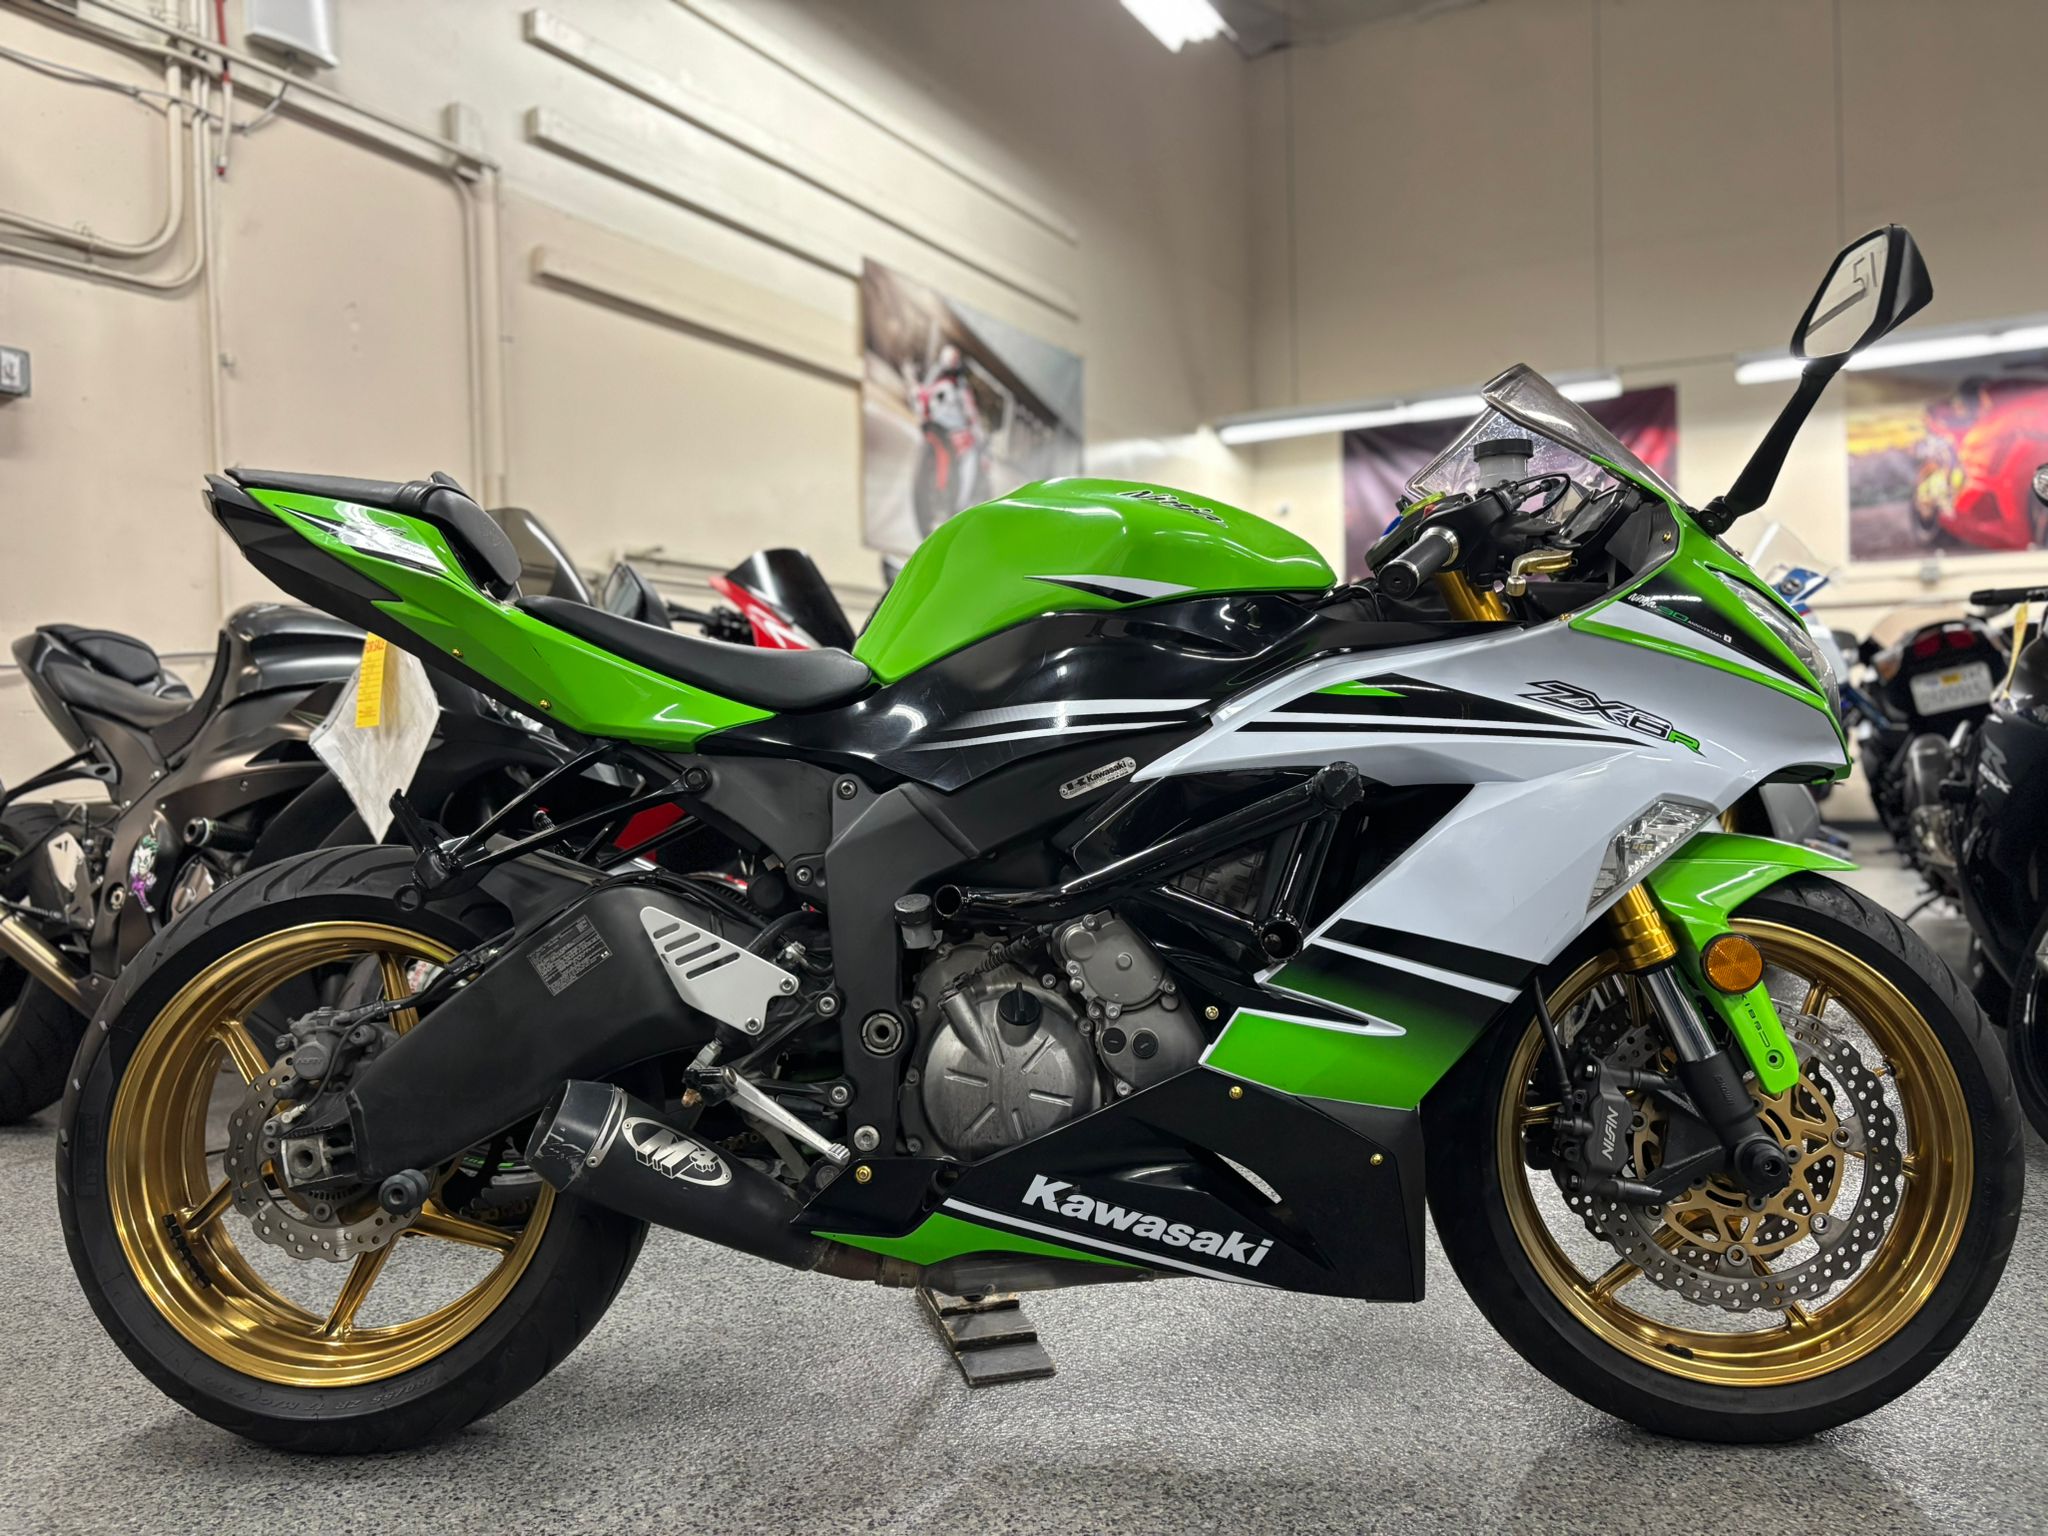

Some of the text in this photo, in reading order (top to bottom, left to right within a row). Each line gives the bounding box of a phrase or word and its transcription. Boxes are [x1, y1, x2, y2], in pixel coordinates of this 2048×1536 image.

[1628, 592, 1657, 609] Ninja
[1086, 760, 1127, 783] Kawasaki
[1021, 1173, 1275, 1267] Kawasaki
